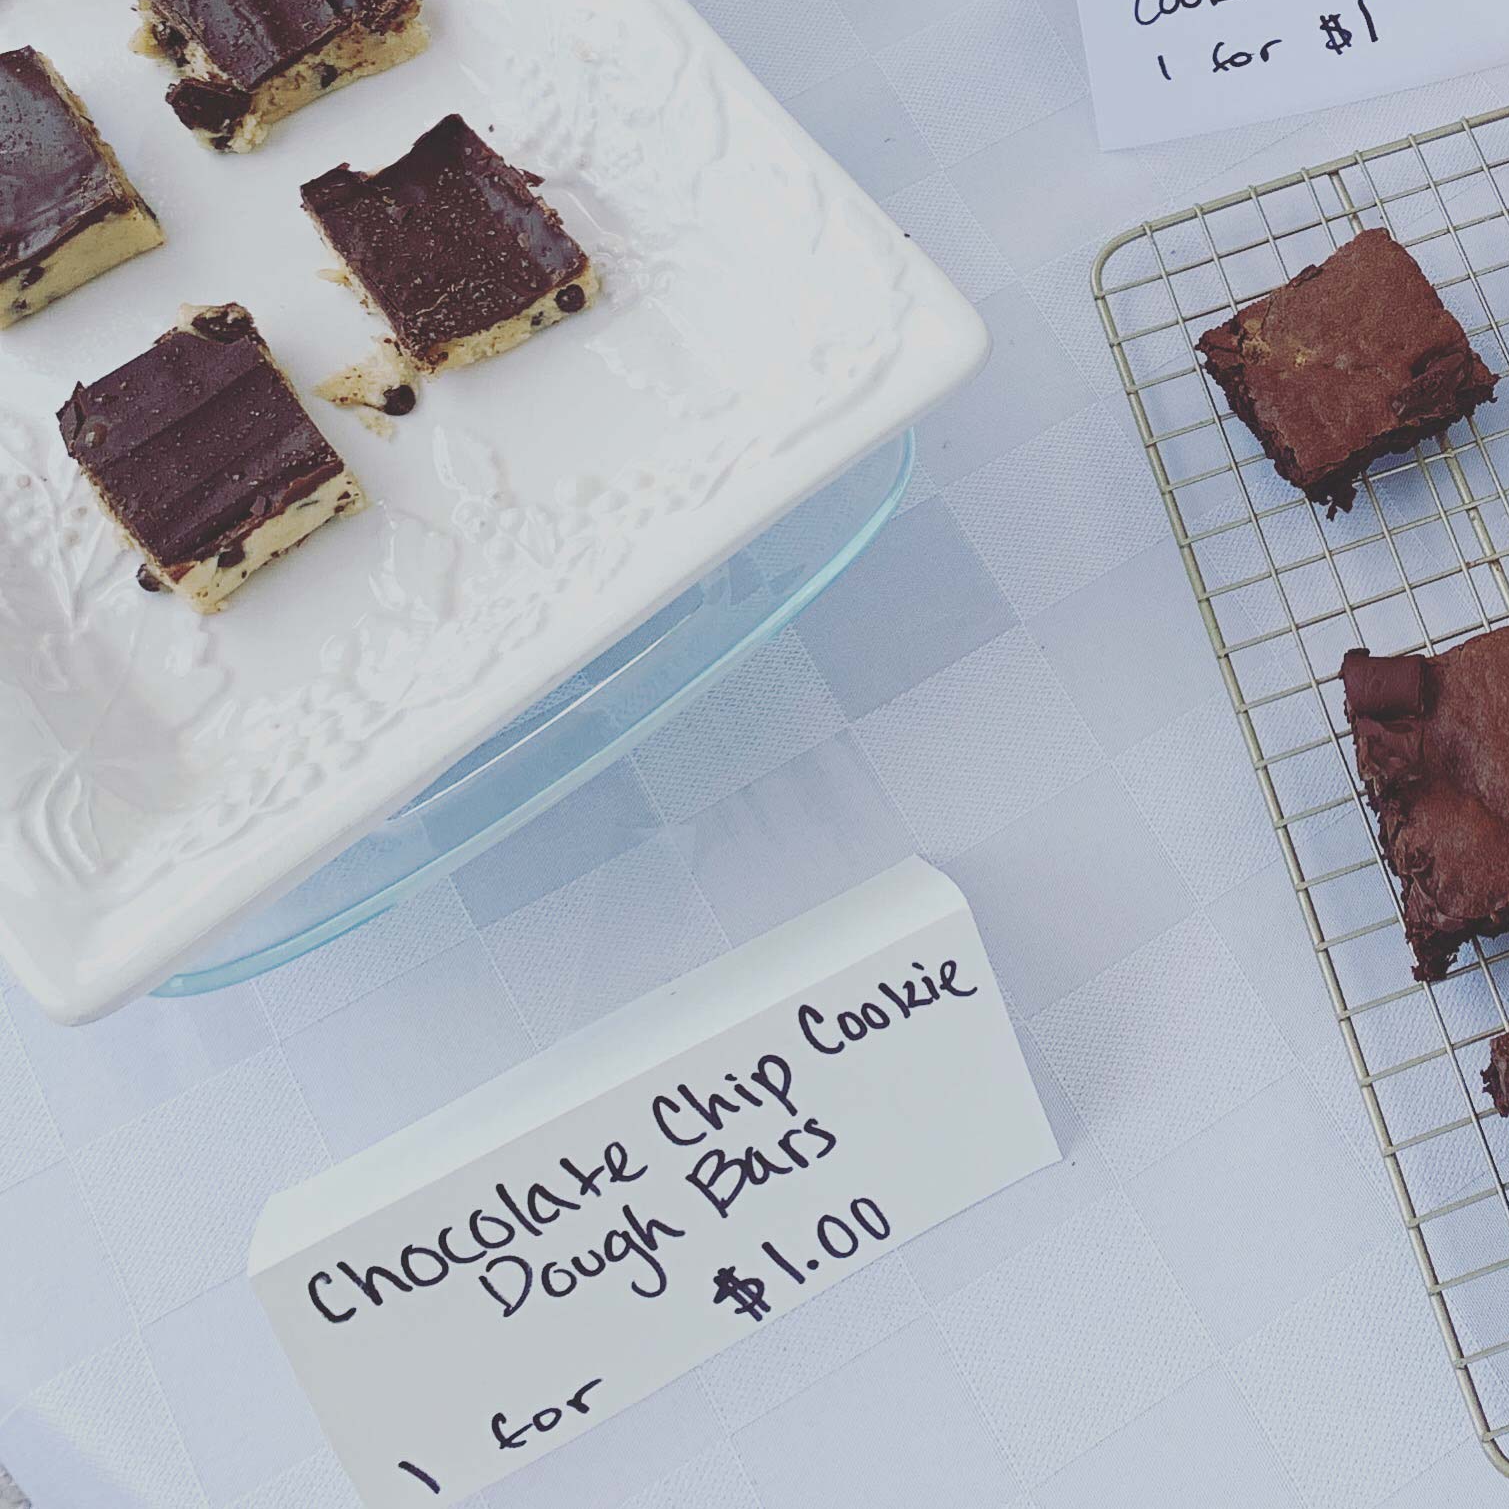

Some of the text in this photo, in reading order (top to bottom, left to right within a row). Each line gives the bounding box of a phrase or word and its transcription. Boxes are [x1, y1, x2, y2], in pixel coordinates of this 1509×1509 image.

[1157, 54, 1172, 81] 1
[1212, 39, 1283, 73] for
[652, 1054, 799, 1146] Chip
[797, 959, 979, 1055] Cookie
[478, 1118, 837, 1318] Dough Bars
[491, 1377, 603, 1450] for
[712, 1197, 891, 1321] $1.00
